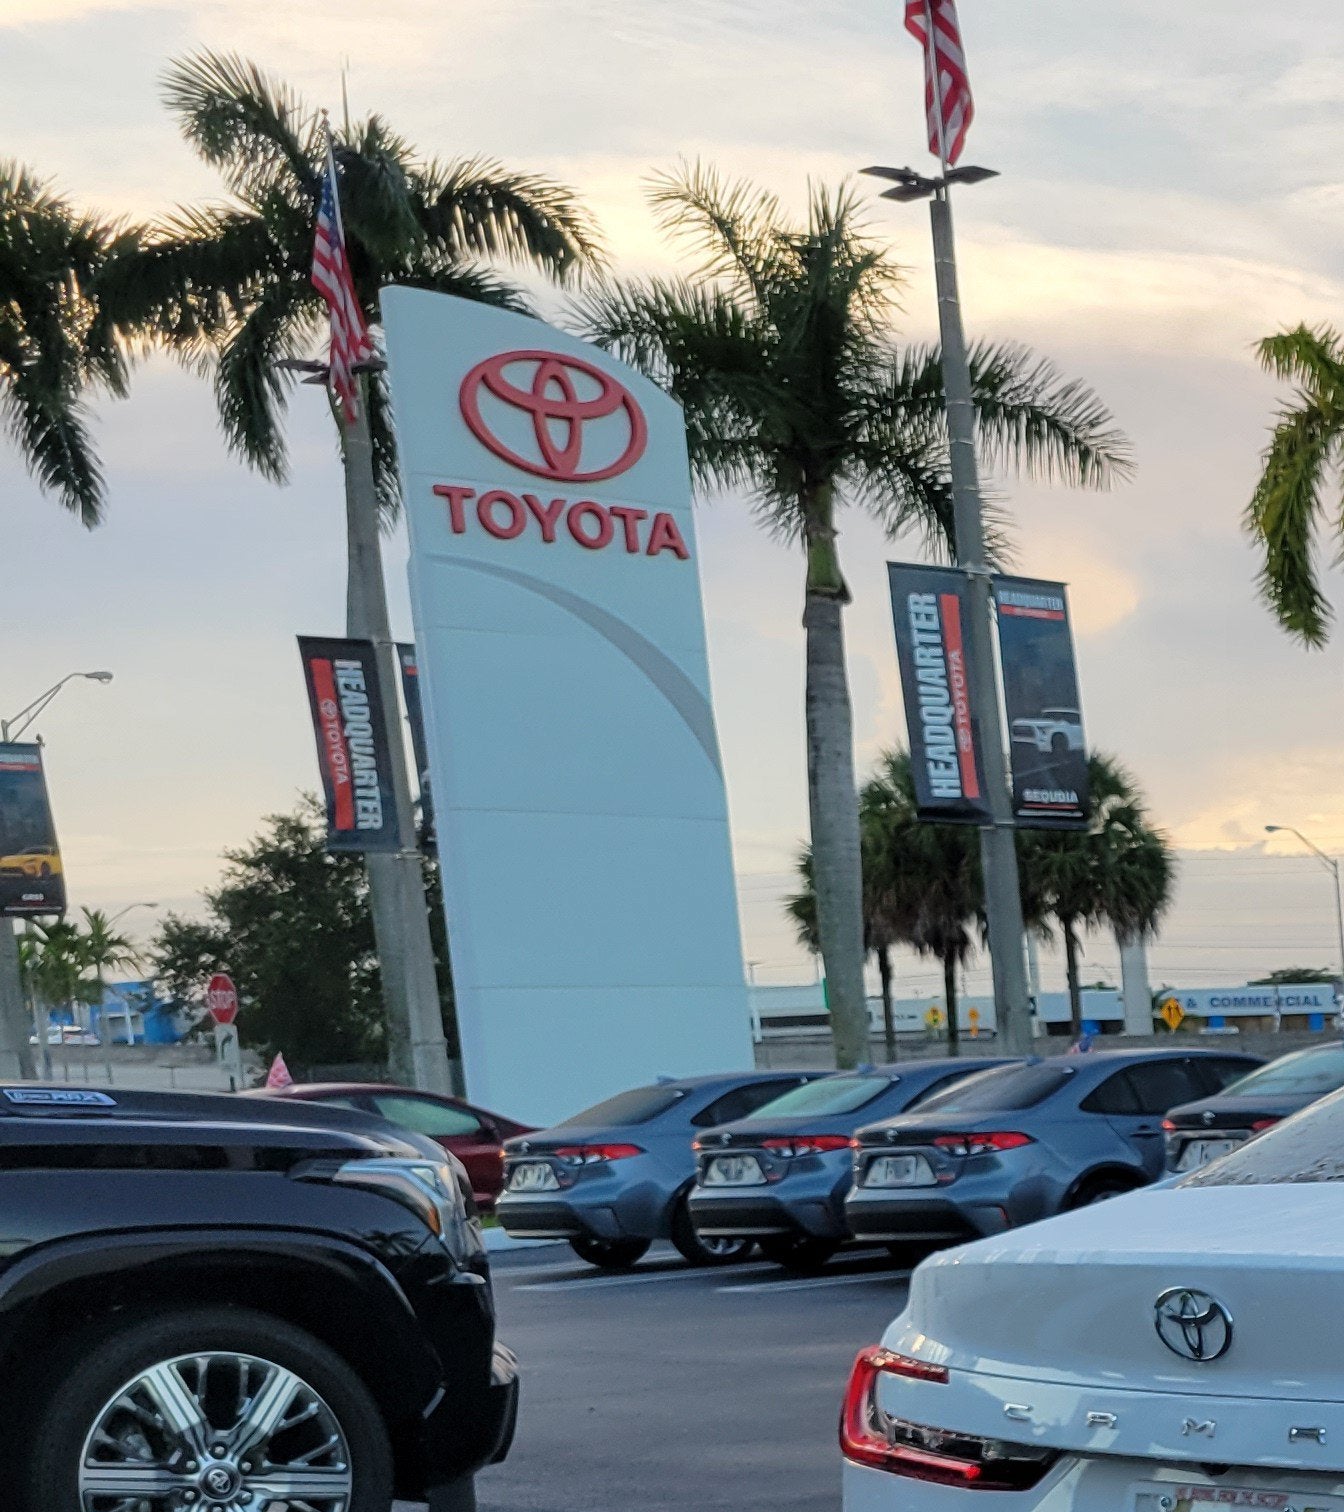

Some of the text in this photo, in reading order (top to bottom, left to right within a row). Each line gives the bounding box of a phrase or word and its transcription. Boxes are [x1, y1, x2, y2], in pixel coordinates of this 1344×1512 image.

[433, 484, 691, 560] TOYOTA
[907, 592, 962, 799] HEADQUARTER
[327, 717, 350, 784] TOYOTA
[334, 658, 383, 831] HEADQUARTER
[208, 990, 236, 1009] STOP
